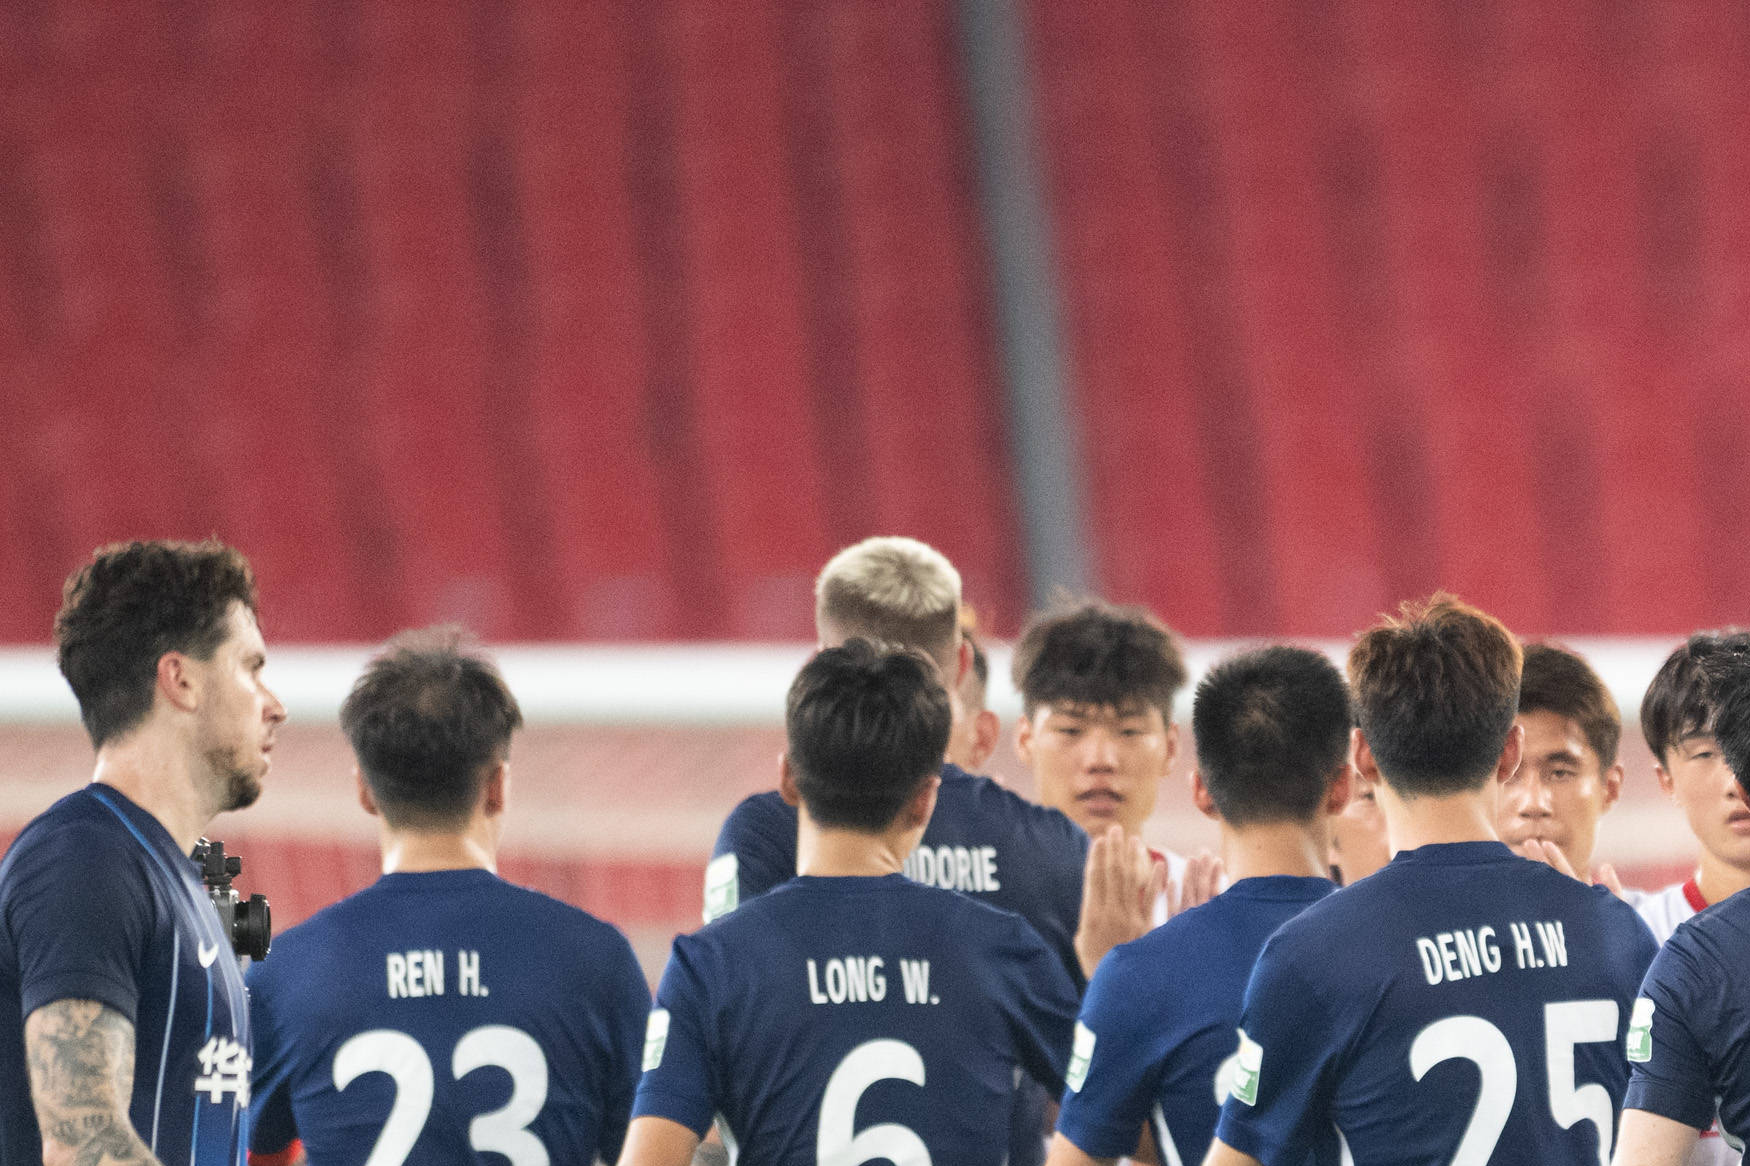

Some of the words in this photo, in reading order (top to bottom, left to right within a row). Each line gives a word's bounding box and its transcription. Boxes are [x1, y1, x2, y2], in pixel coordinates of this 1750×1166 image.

[386, 949, 445, 999] REN
[458, 950, 489, 997] H.
[1416, 925, 1502, 987] DENG
[1514, 920, 1568, 970] H.W
[806, 956, 887, 1005] LONG
[899, 959, 940, 1005] W.
